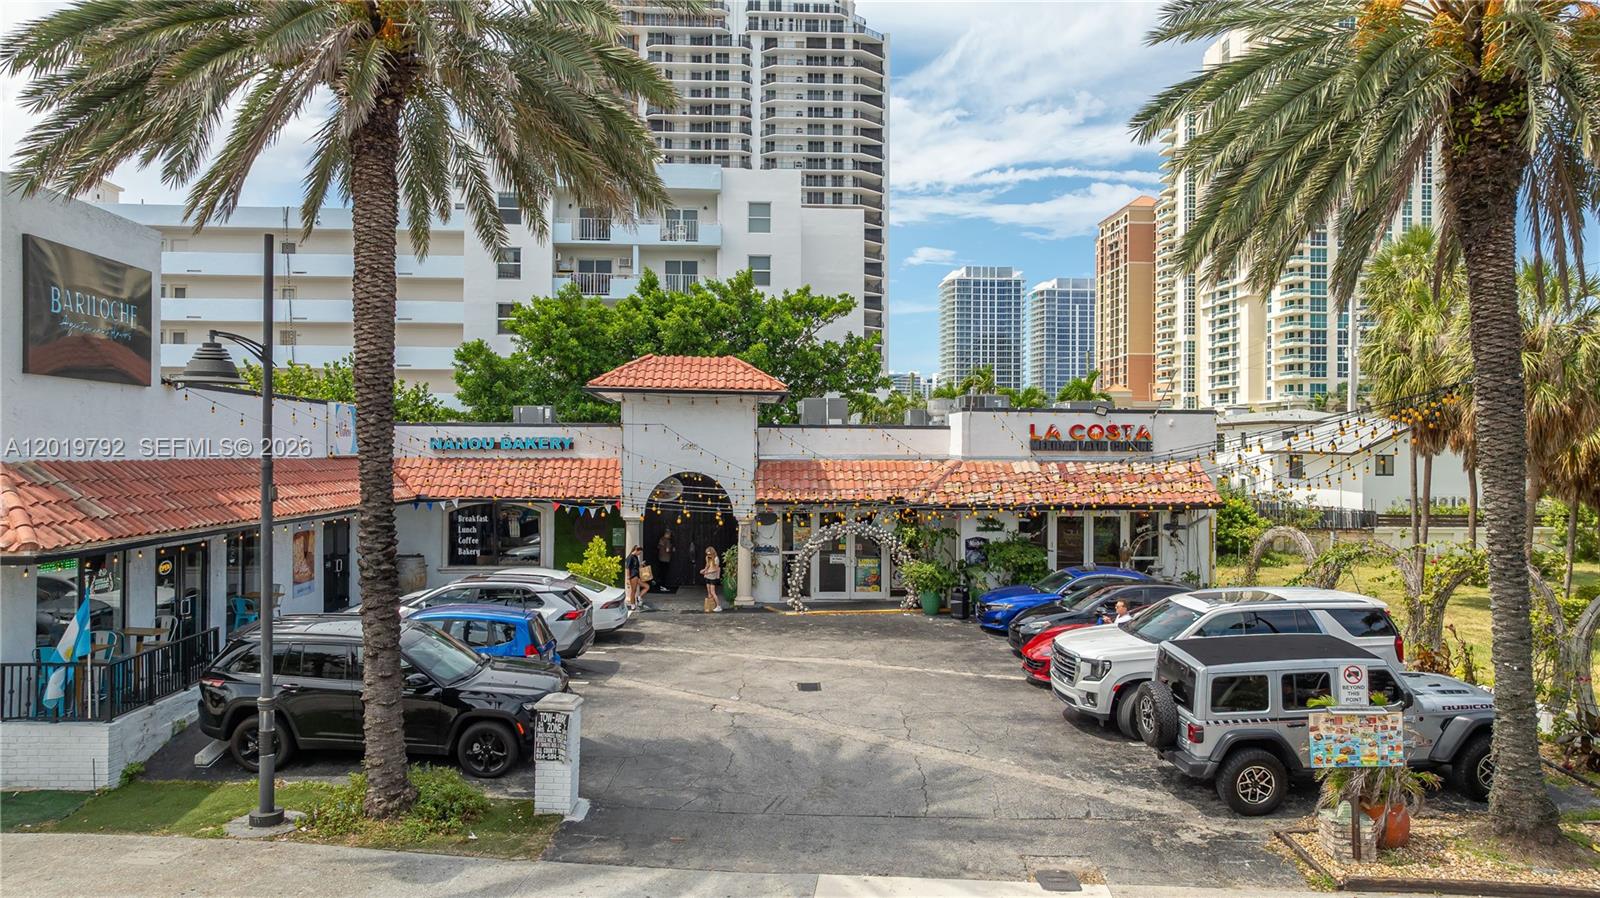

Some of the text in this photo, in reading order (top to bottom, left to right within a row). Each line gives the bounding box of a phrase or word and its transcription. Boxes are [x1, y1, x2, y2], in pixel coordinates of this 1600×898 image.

[50, 286, 138, 329] BARILOCHE
[1029, 424, 1152, 440] LA COSTA
[430, 437, 573, 450] NANOU BAKERY
[458, 548, 480, 557] Bakery
[547, 722, 562, 733] ZONE
